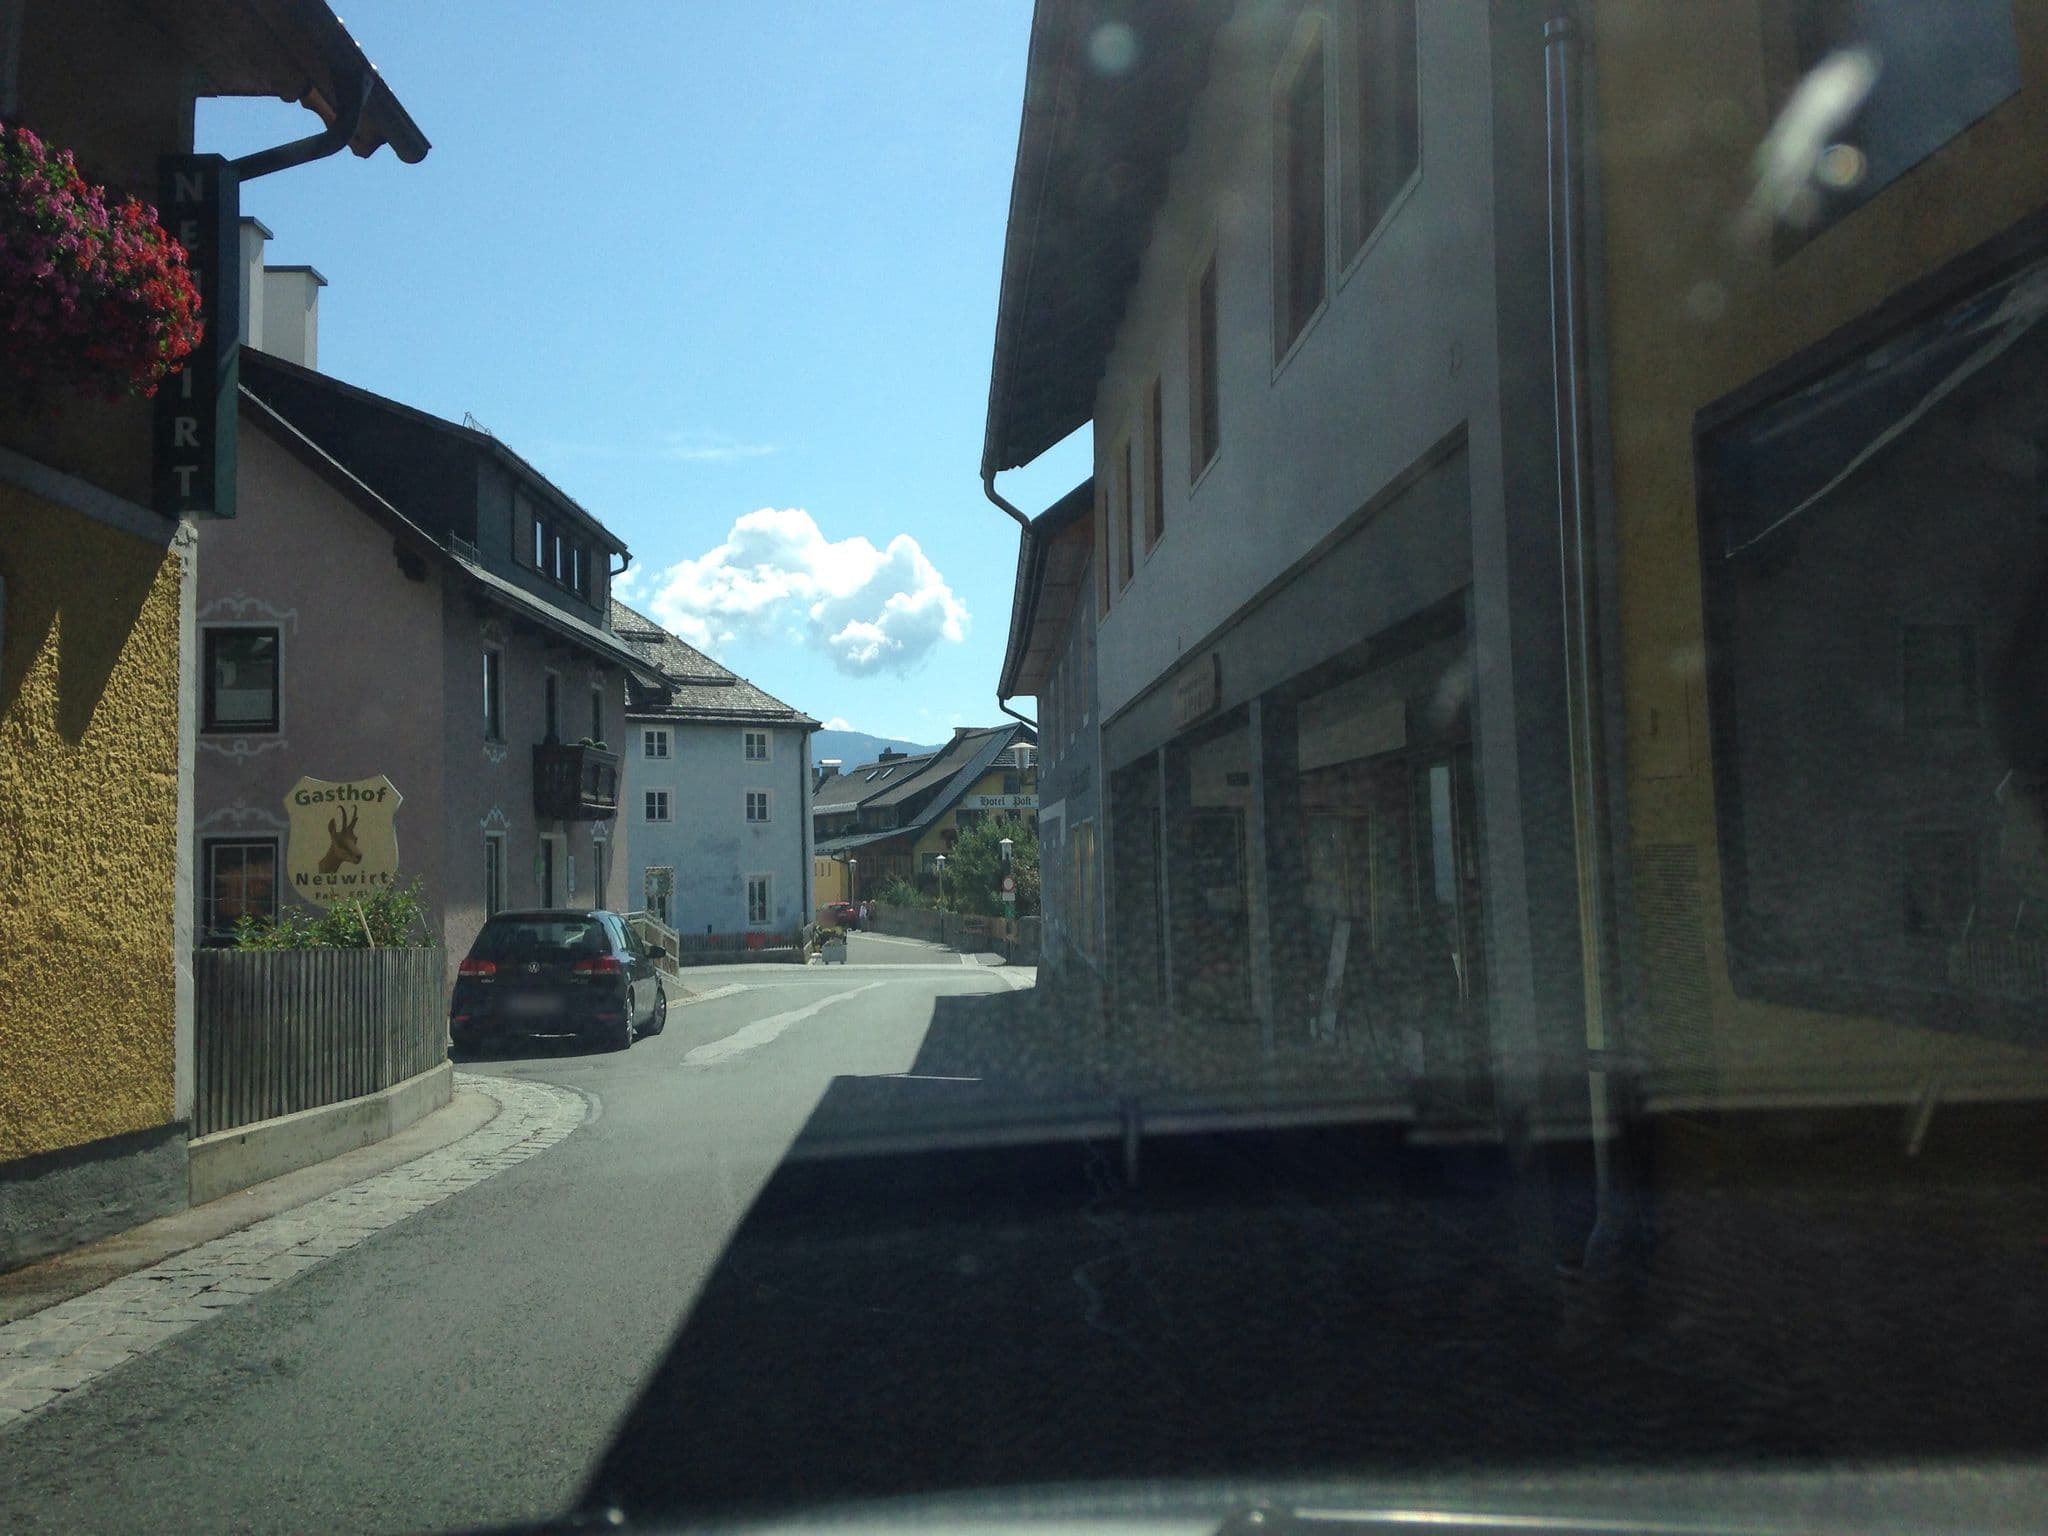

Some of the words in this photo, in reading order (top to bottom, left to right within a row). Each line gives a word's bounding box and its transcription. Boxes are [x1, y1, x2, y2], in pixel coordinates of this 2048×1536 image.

[173, 172, 203, 497] NEIRT
[294, 784, 387, 806] Gasthof
[980, 796, 1005, 806] Hotel
[296, 870, 389, 886] Neuwirt
